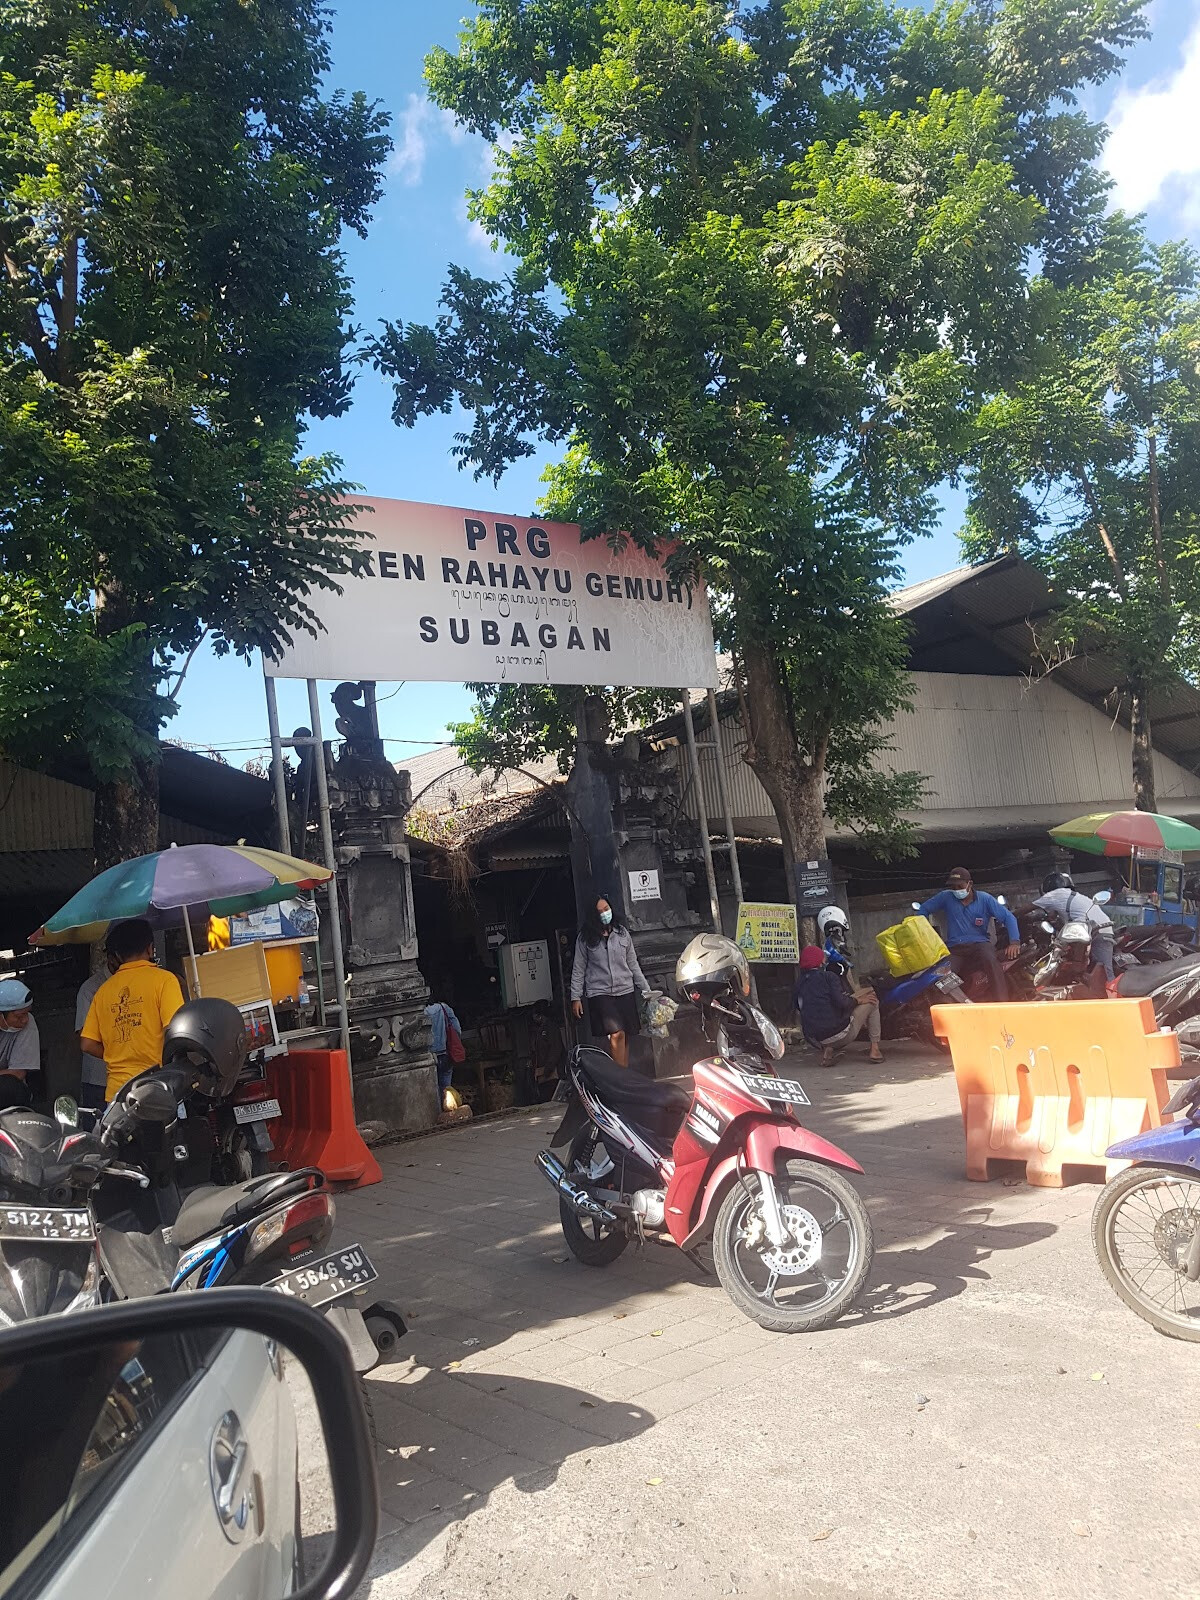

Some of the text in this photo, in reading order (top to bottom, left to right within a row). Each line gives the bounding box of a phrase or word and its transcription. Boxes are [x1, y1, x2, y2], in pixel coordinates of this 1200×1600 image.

[464, 518, 552, 559] PRG
[441, 556, 572, 595] RAHAYU
[420, 616, 612, 653] SUBAGAN
[743, 1076, 759, 1089] DK
[17, 1120, 53, 1129] HONDA
[695, 1103, 720, 1131] YAMAHA
[7, 1211, 89, 1227] 5124 TM
[291, 1249, 314, 1262] HONDA
[295, 1261, 339, 1290] 5646
[340, 1250, 363, 1271] SU
